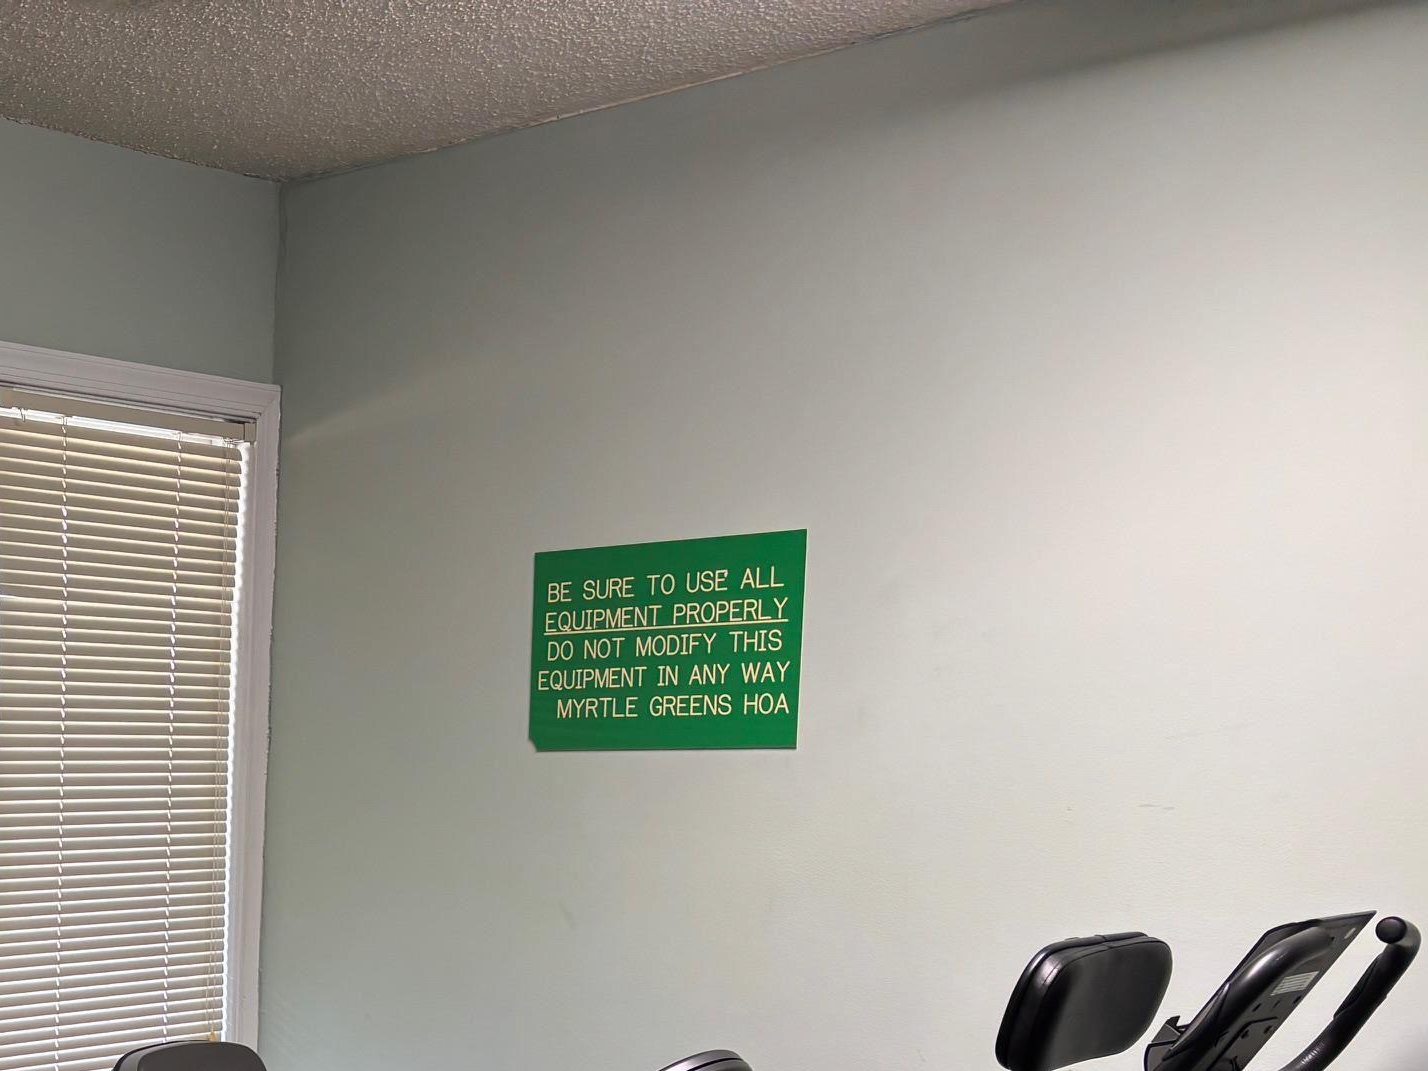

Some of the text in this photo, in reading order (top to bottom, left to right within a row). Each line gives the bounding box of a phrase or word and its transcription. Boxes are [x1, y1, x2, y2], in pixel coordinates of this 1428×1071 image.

[548, 565, 785, 603] BE SURE TO USE ALL
[545, 597, 788, 633] EQUIPMENT PROPERLY
[547, 629, 783, 662] DO NOT MODIFY THIS
[538, 661, 790, 691] EQUIPMENT IN ANY WAY
[557, 693, 790, 719] MYRTLE GREENS HOA
